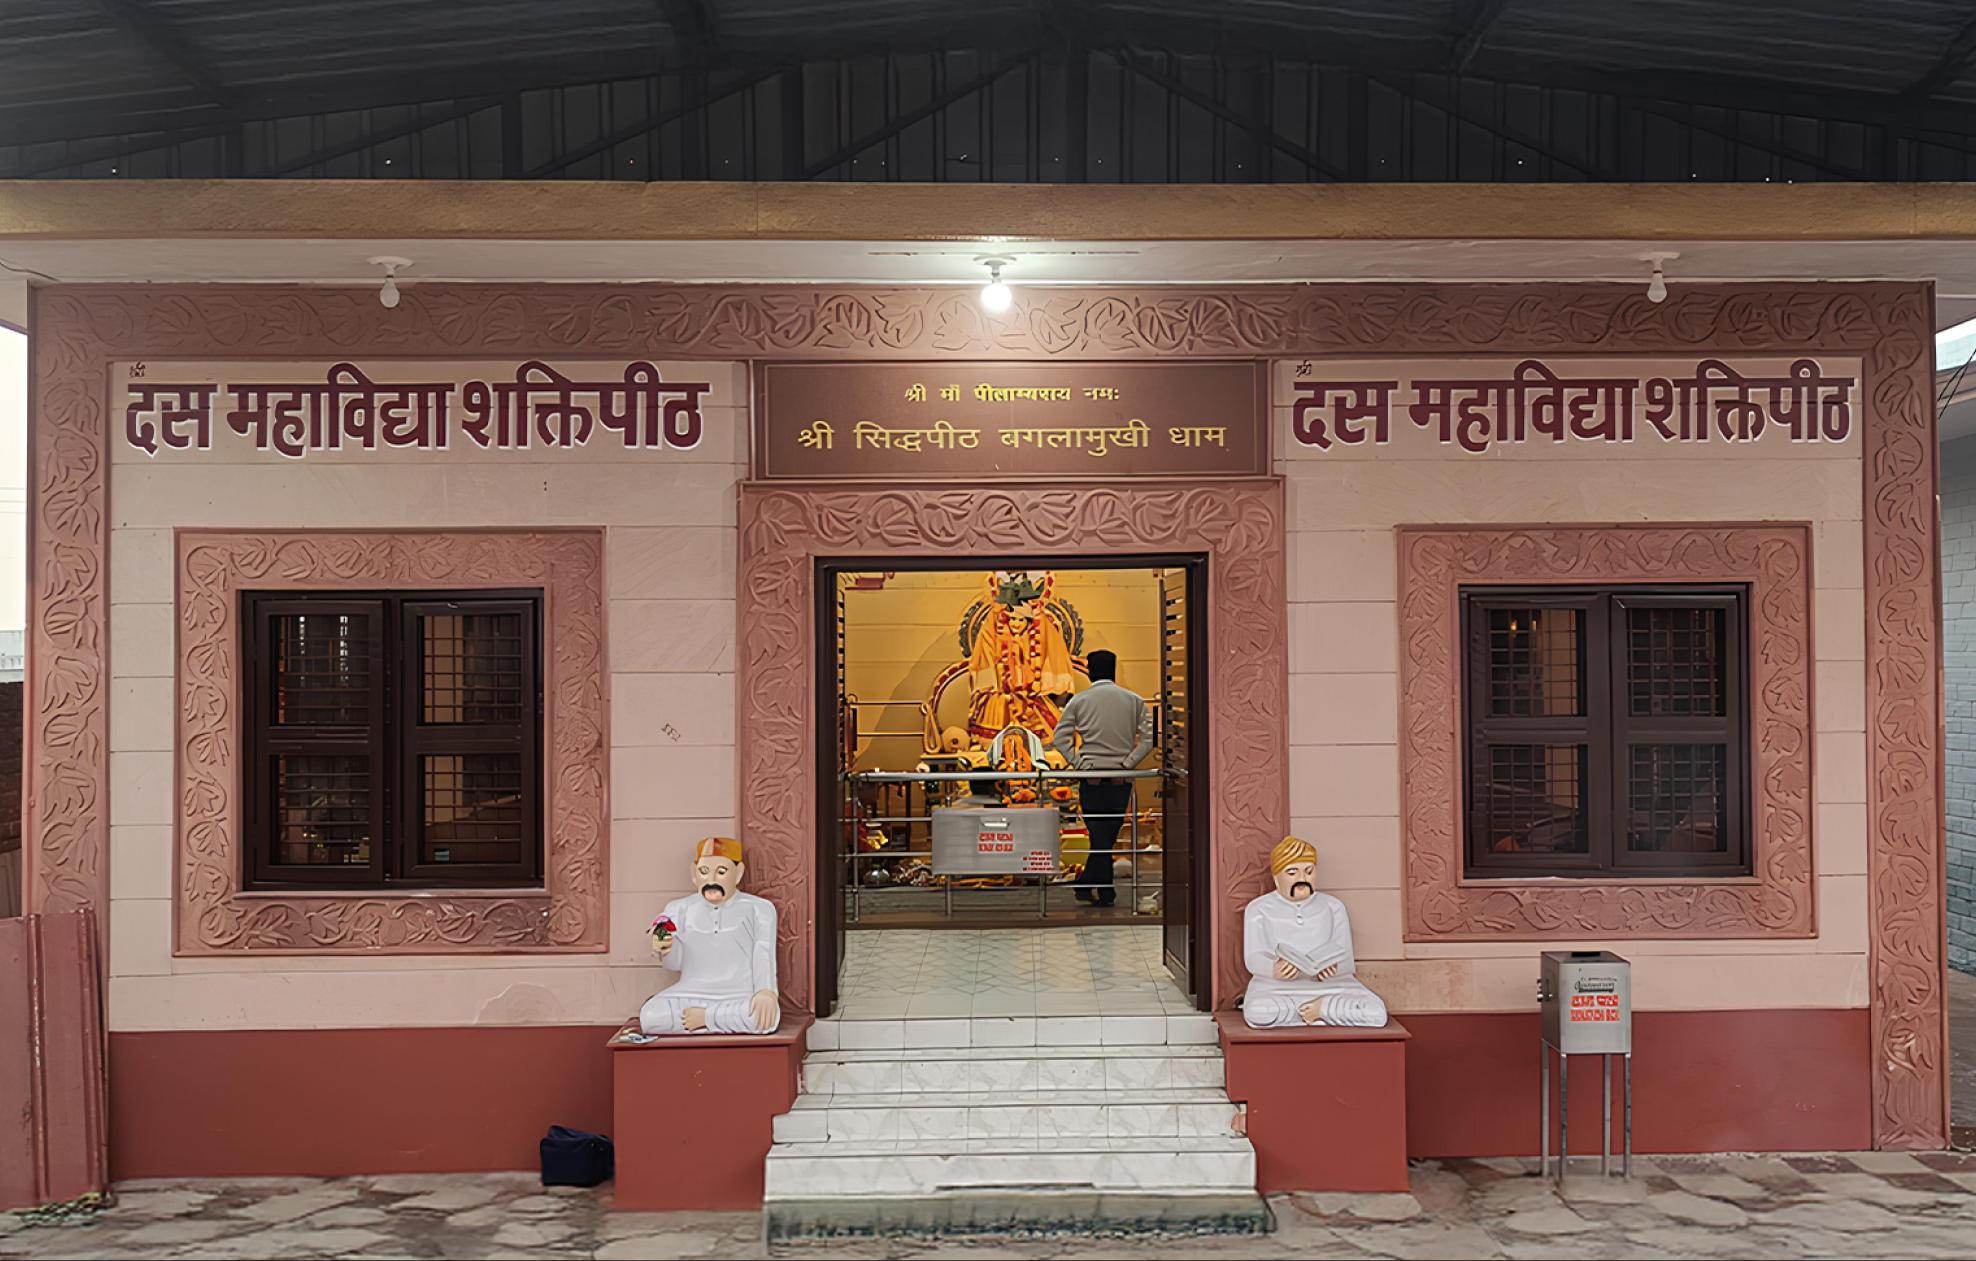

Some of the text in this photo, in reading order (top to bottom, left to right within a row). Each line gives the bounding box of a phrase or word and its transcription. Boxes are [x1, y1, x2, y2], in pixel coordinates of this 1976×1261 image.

[126, 360, 711, 458] दस महाविद्या शक्तिपीठ
[904, 383, 927, 402] श्री
[1293, 358, 1855, 454] दस महाविद्या शक्तिपीठ
[797, 418, 1227, 457] श्री सिद्धपीठ बगलामुखी धाम
